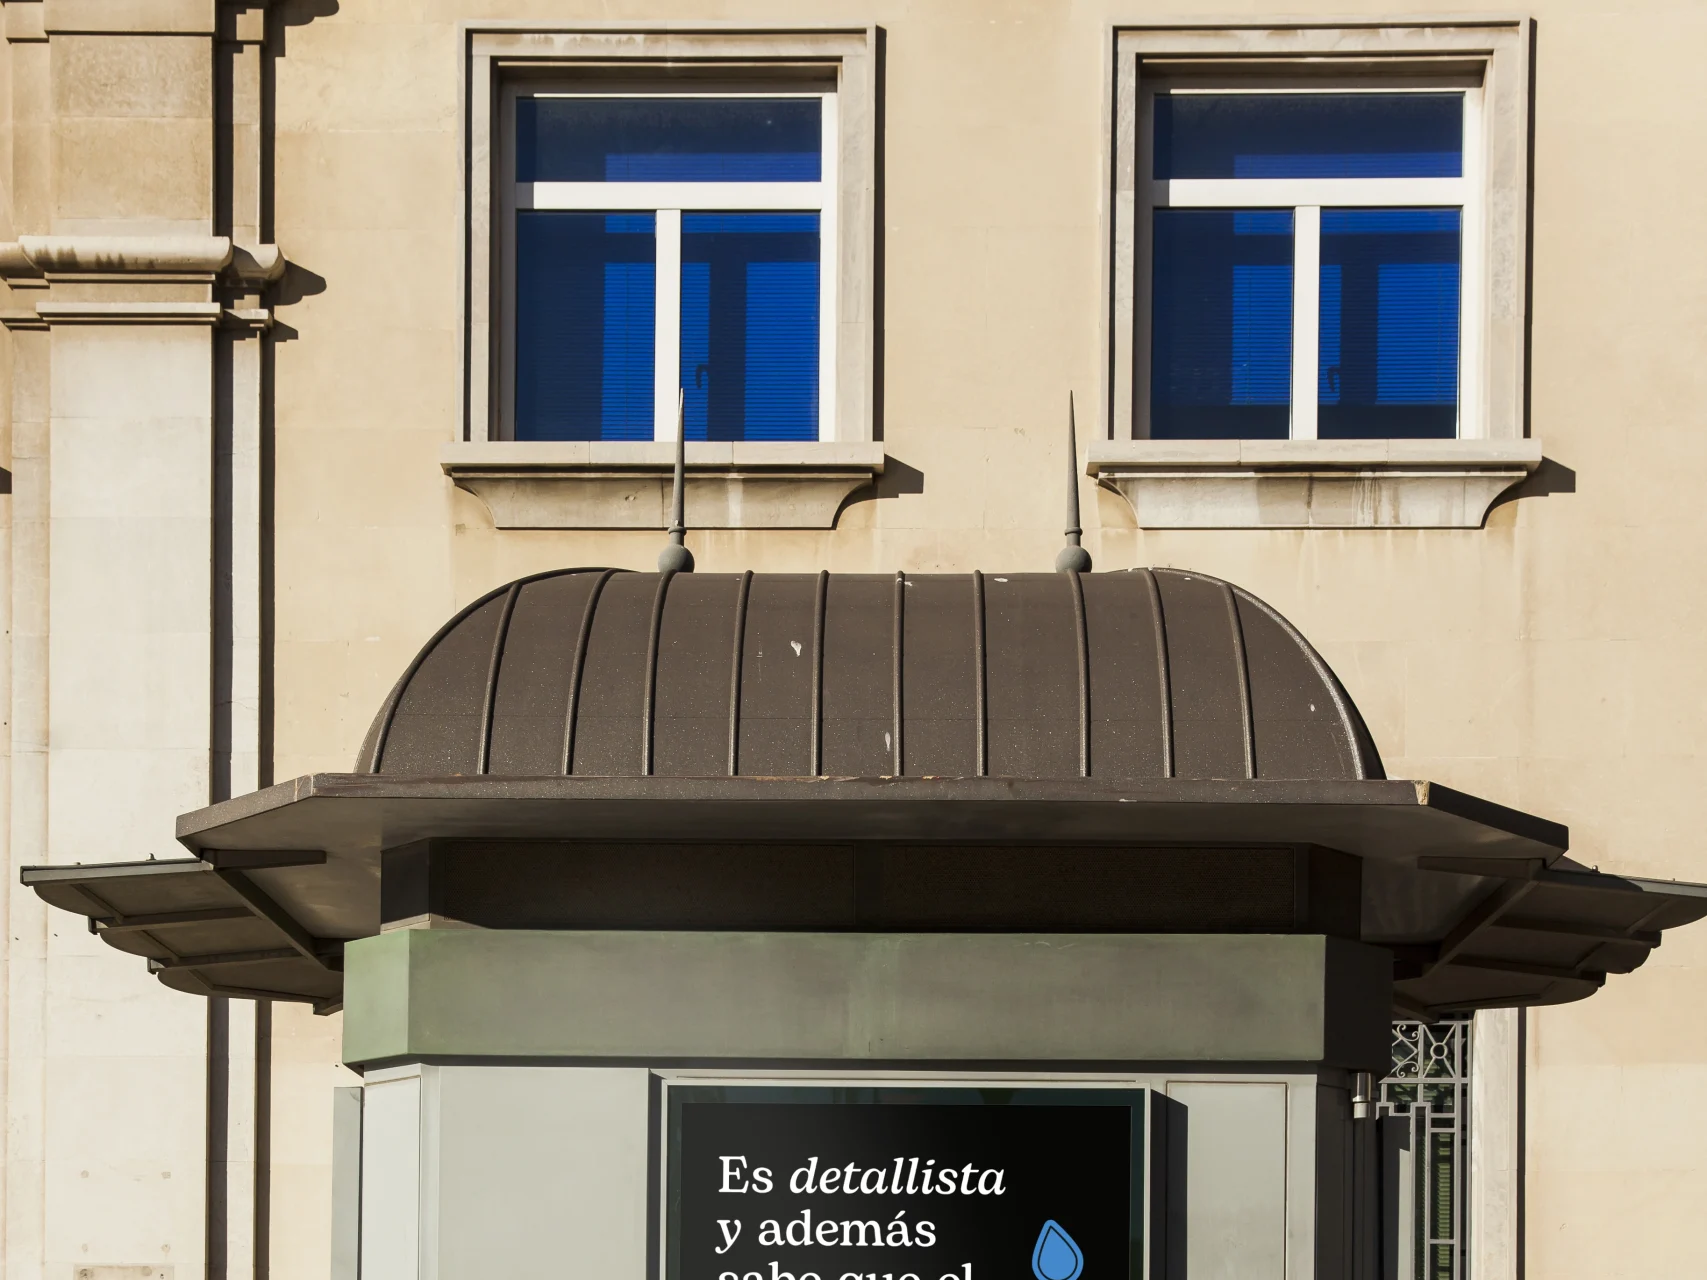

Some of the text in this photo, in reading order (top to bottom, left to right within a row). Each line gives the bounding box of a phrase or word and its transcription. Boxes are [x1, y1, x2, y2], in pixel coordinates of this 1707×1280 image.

[718, 1155, 1007, 1196] Es detallista
[714, 1208, 937, 1255] y además
